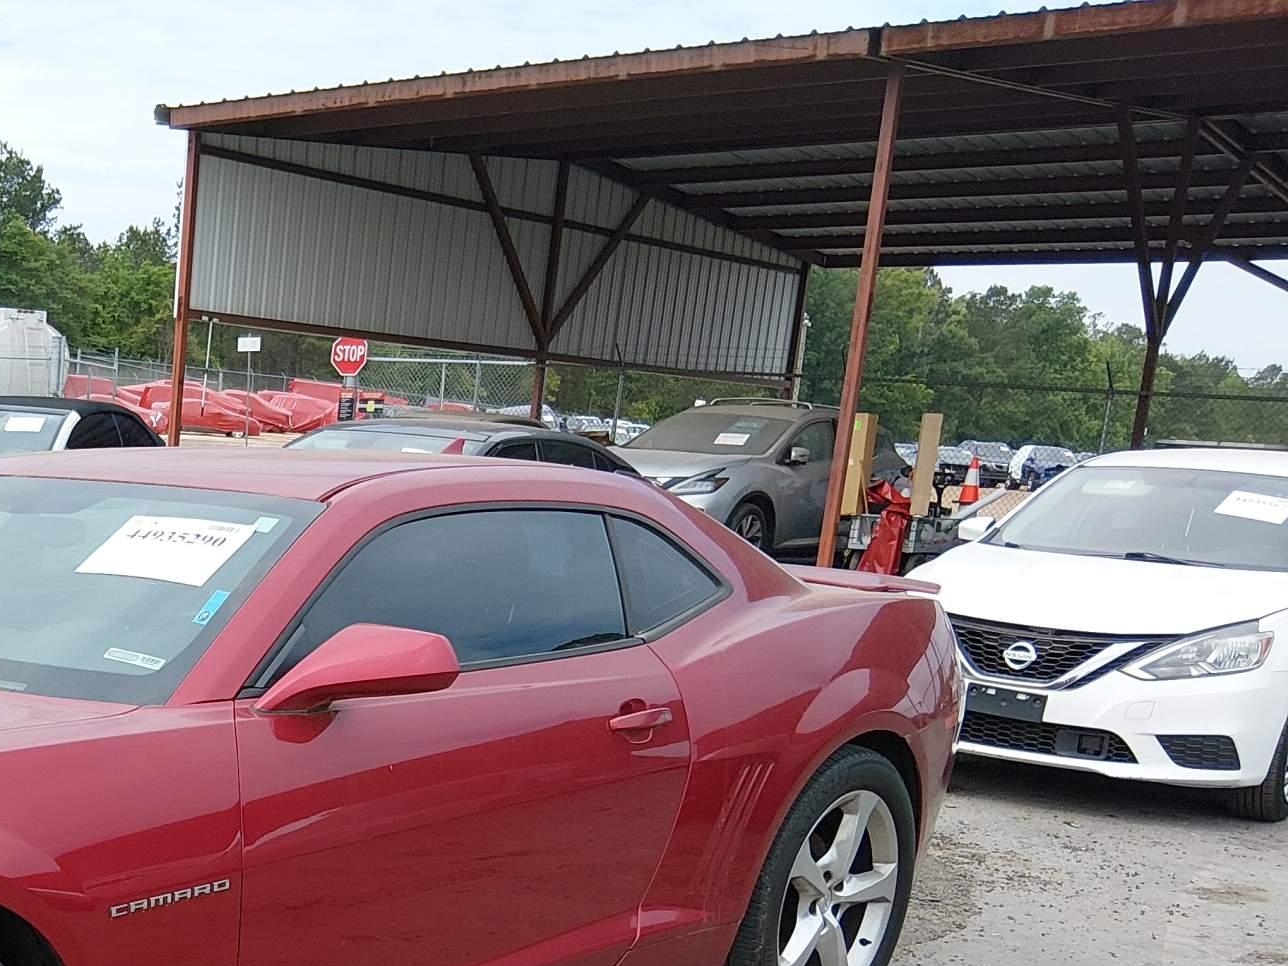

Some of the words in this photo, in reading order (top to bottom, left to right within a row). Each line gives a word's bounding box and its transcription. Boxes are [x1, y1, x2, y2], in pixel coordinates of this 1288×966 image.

[334, 345, 365, 362] STOP
[126, 529, 227, 547] 44935290
[109, 878, 230, 918] CAMARO
